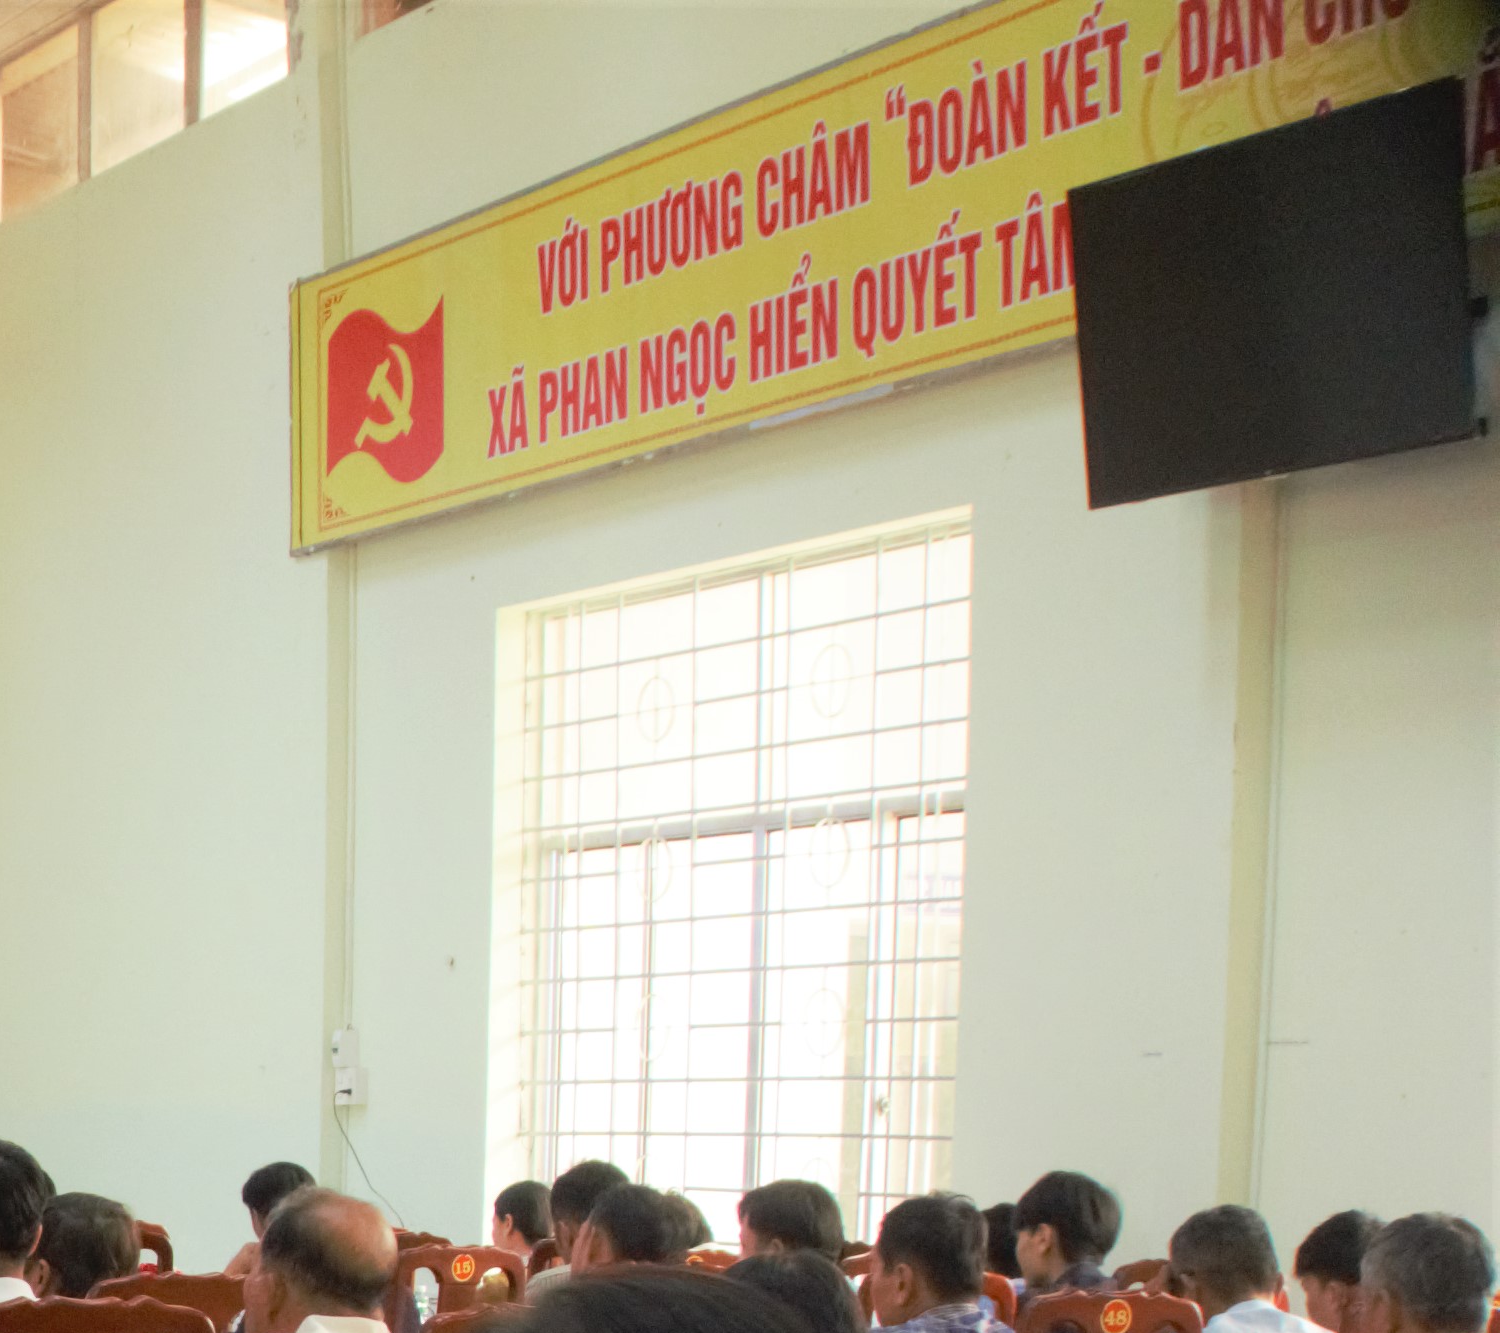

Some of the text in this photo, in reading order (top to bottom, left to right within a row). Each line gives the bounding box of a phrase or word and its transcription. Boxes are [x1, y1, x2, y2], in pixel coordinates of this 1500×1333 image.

[538, 220, 588, 314] VỚI
[601, 172, 742, 293] PHƯƠNG
[757, 122, 869, 237] CHÂM
[1043, 0, 1126, 136] KẾT
[487, 363, 529, 459] XÃ
[539, 348, 627, 442] PHAN
[640, 313, 735, 415] NGỌC
[750, 254, 838, 382] HIỂN
[853, 212, 981, 357] QUYẾT
[1105, 1310, 1127, 1326] 48
